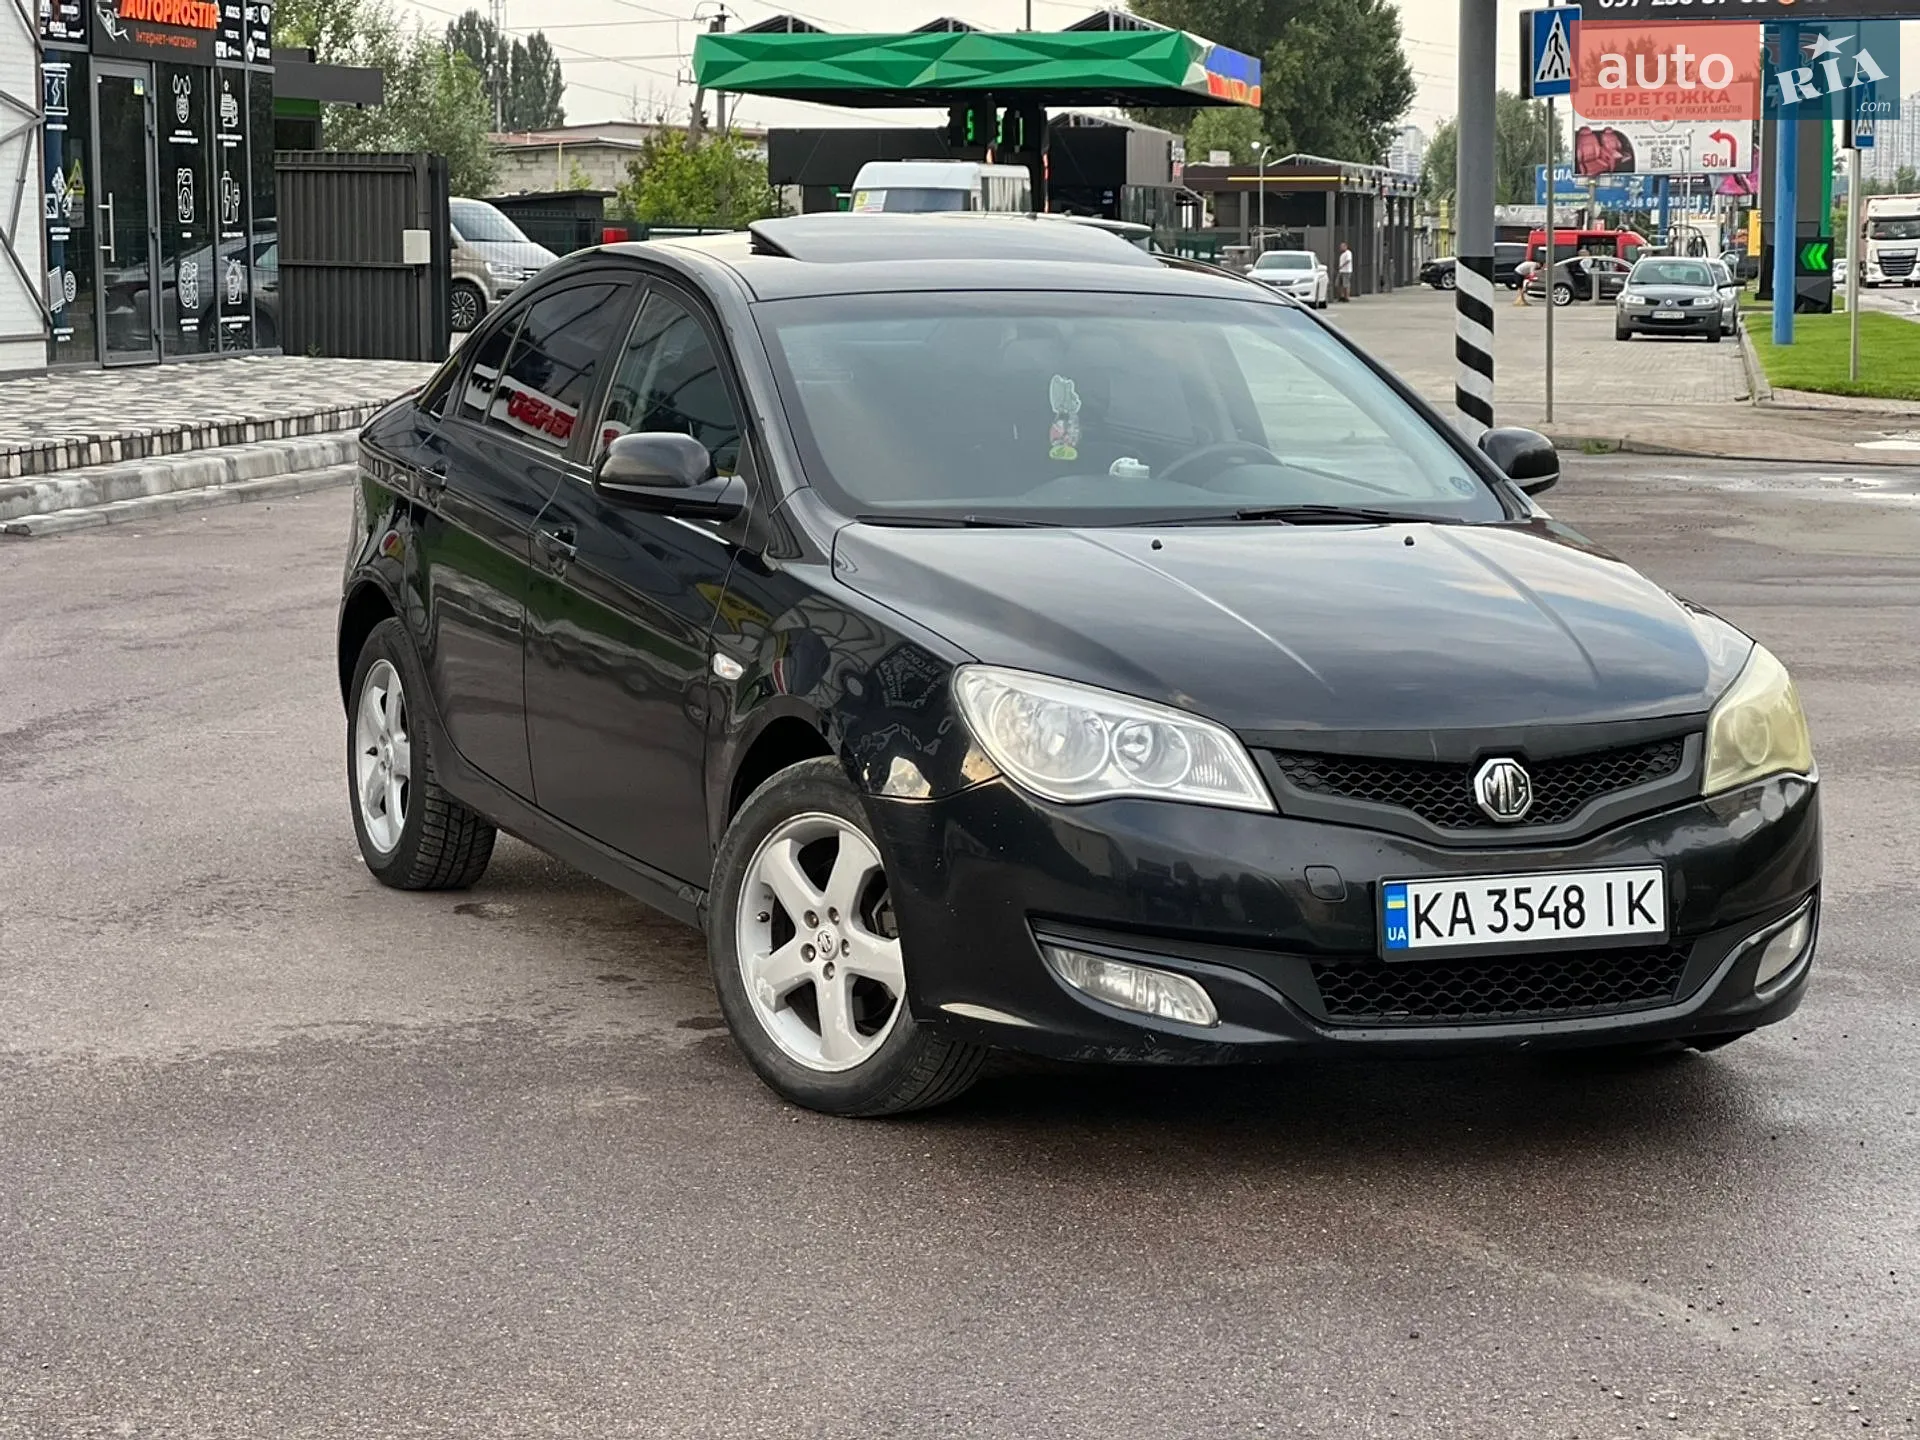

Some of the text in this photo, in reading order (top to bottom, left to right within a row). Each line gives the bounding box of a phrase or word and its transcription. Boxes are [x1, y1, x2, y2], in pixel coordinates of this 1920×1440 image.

[1595, 90, 1731, 106] ПЕРЕТЯЖКА
[1585, 107, 1649, 117] САЛОНІВ АВТО
[1484, 765, 1527, 813] MG
[1414, 879, 1657, 939] KA 3548 IK
[1387, 927, 1407, 941] UA
